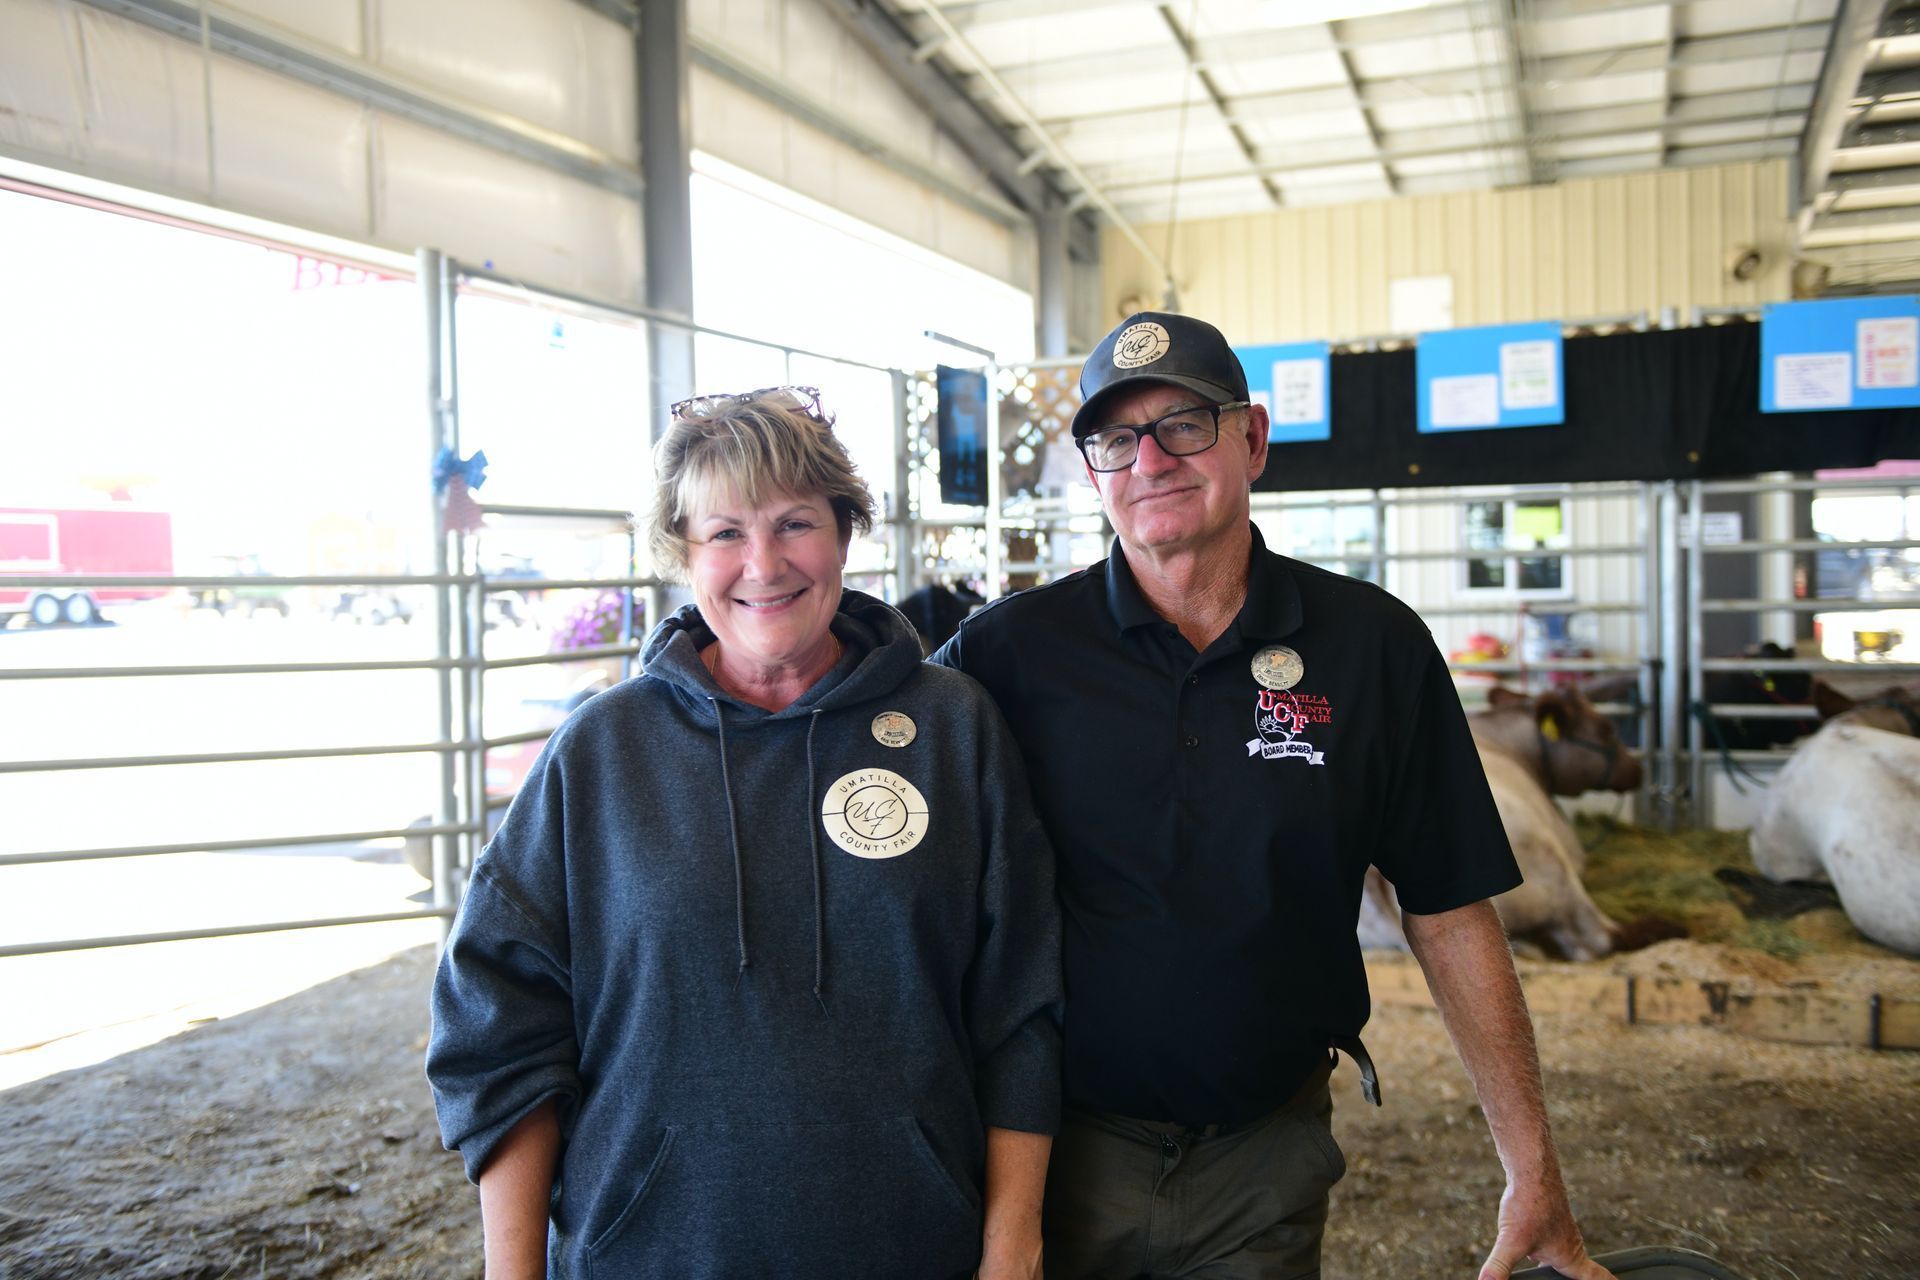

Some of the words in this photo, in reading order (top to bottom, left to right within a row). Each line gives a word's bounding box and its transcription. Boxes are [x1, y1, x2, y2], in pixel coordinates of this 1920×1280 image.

[1118, 324, 1159, 343] UMATILLA
[1145, 350, 1162, 362] FAIR
[1258, 690, 1329, 711] UMATILLA
[1273, 702, 1333, 723] COUNTY
[1290, 713, 1332, 734] FAIR
[1263, 745, 1284, 757] BOARD
[1286, 743, 1312, 755] MEMBER
[839, 774, 907, 793] UMATILLA
[839, 831, 888, 852] COUNTY
[894, 830, 917, 849] FAIR
